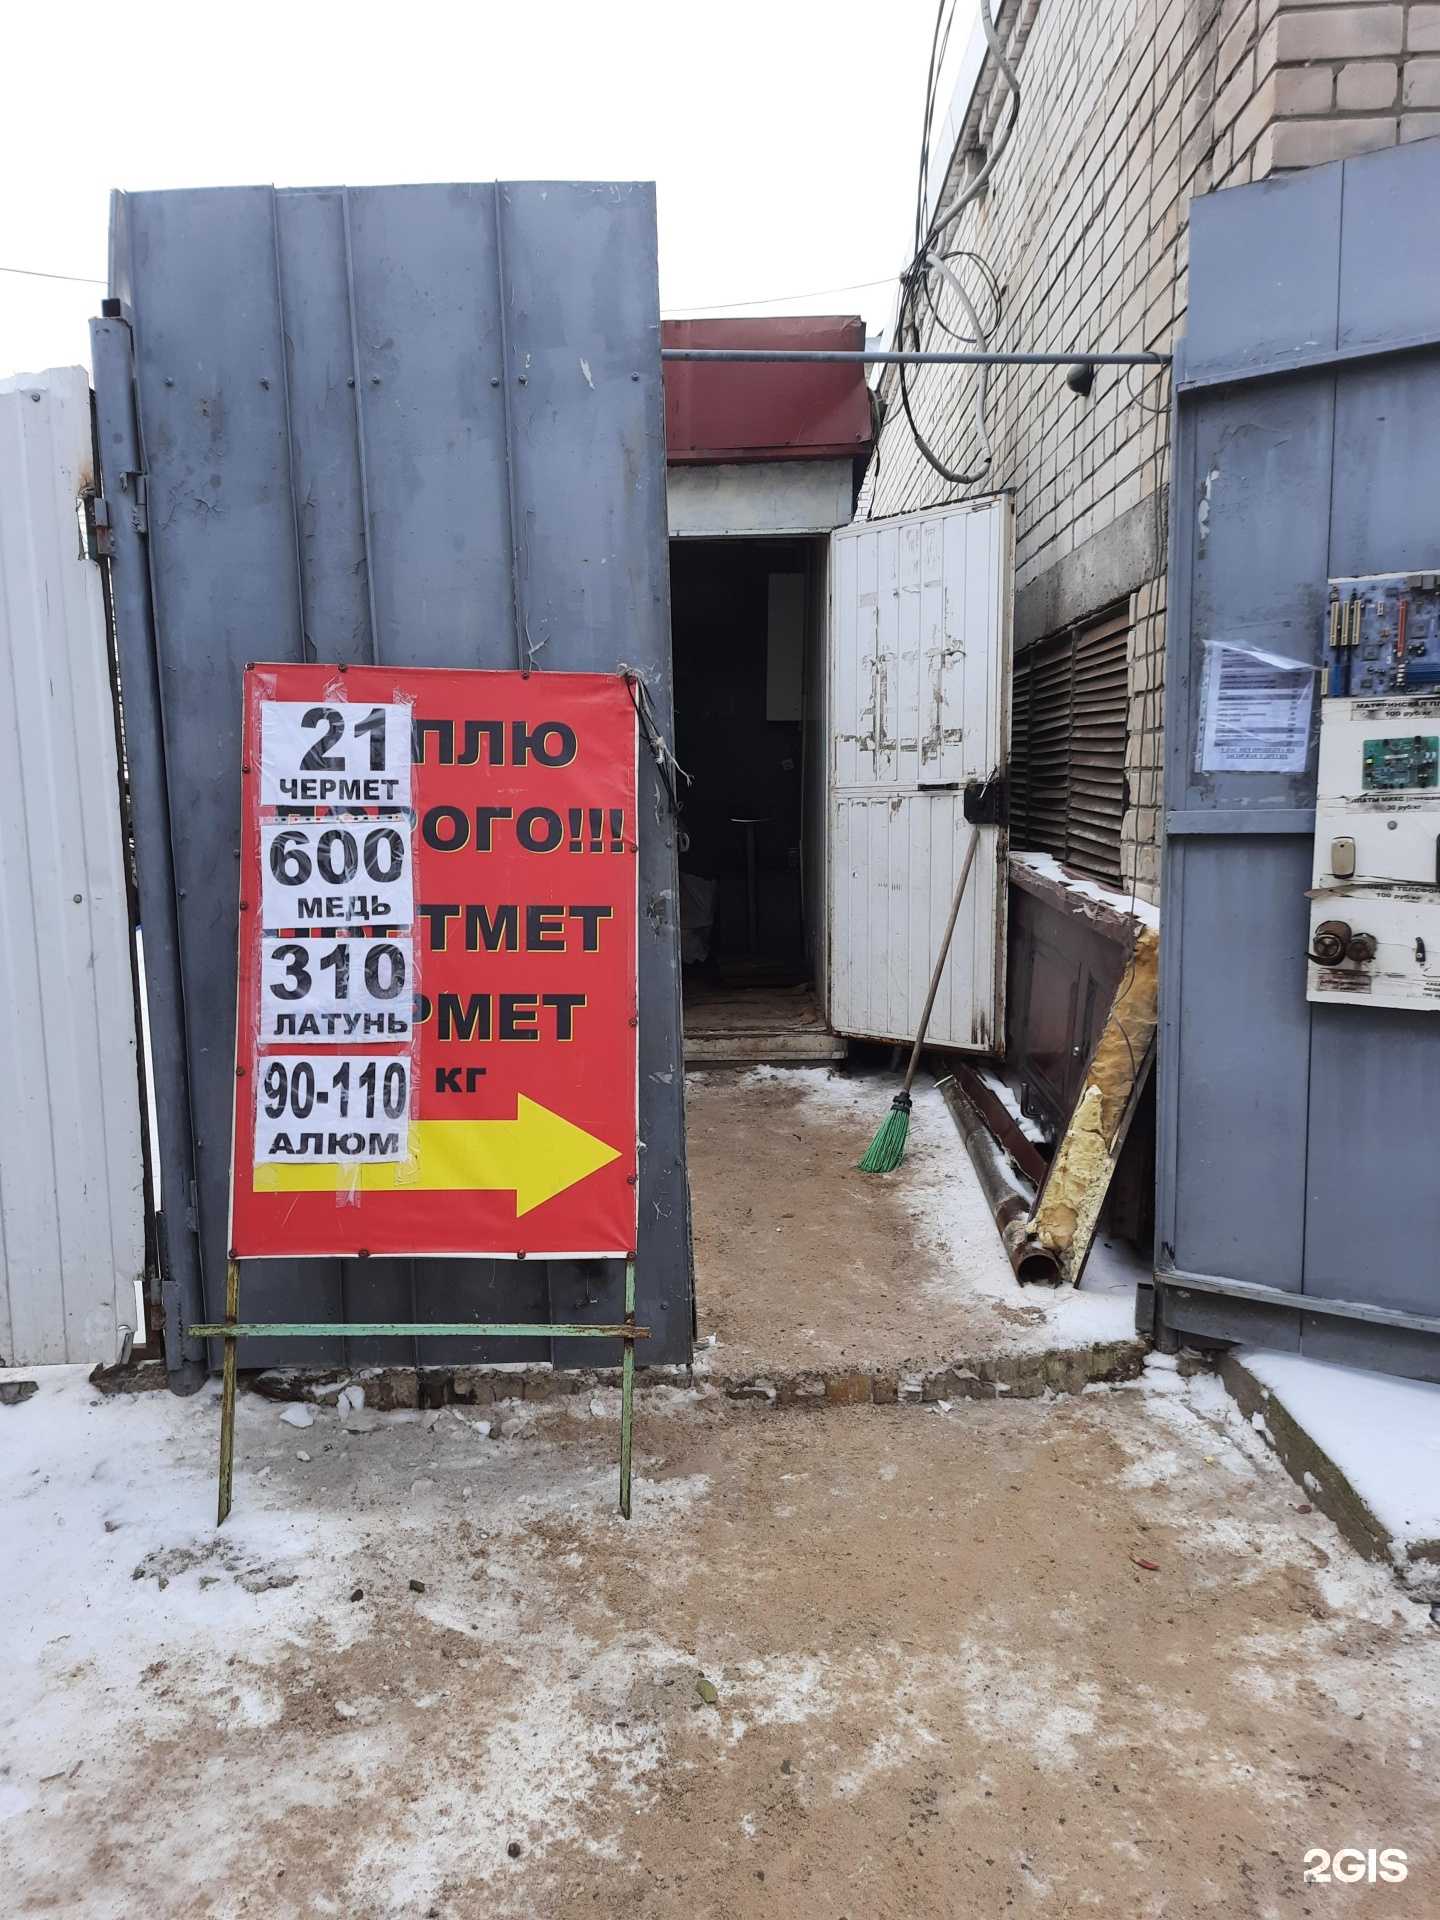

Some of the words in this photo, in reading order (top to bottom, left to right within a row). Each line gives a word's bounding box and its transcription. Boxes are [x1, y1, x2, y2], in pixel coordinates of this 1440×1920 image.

[299, 706, 388, 772] 21
[411, 719, 578, 769] ПЛЮ
[279, 778, 401, 801] ЧЕРМЕТ
[269, 827, 405, 887] 600
[297, 894, 392, 922] МЕДЬ
[269, 943, 407, 1001] 310
[273, 1012, 409, 1036] ЛАТУНЬ
[264, 1060, 408, 1120] 90-110
[268, 1131, 400, 1156] АЛЮМ
